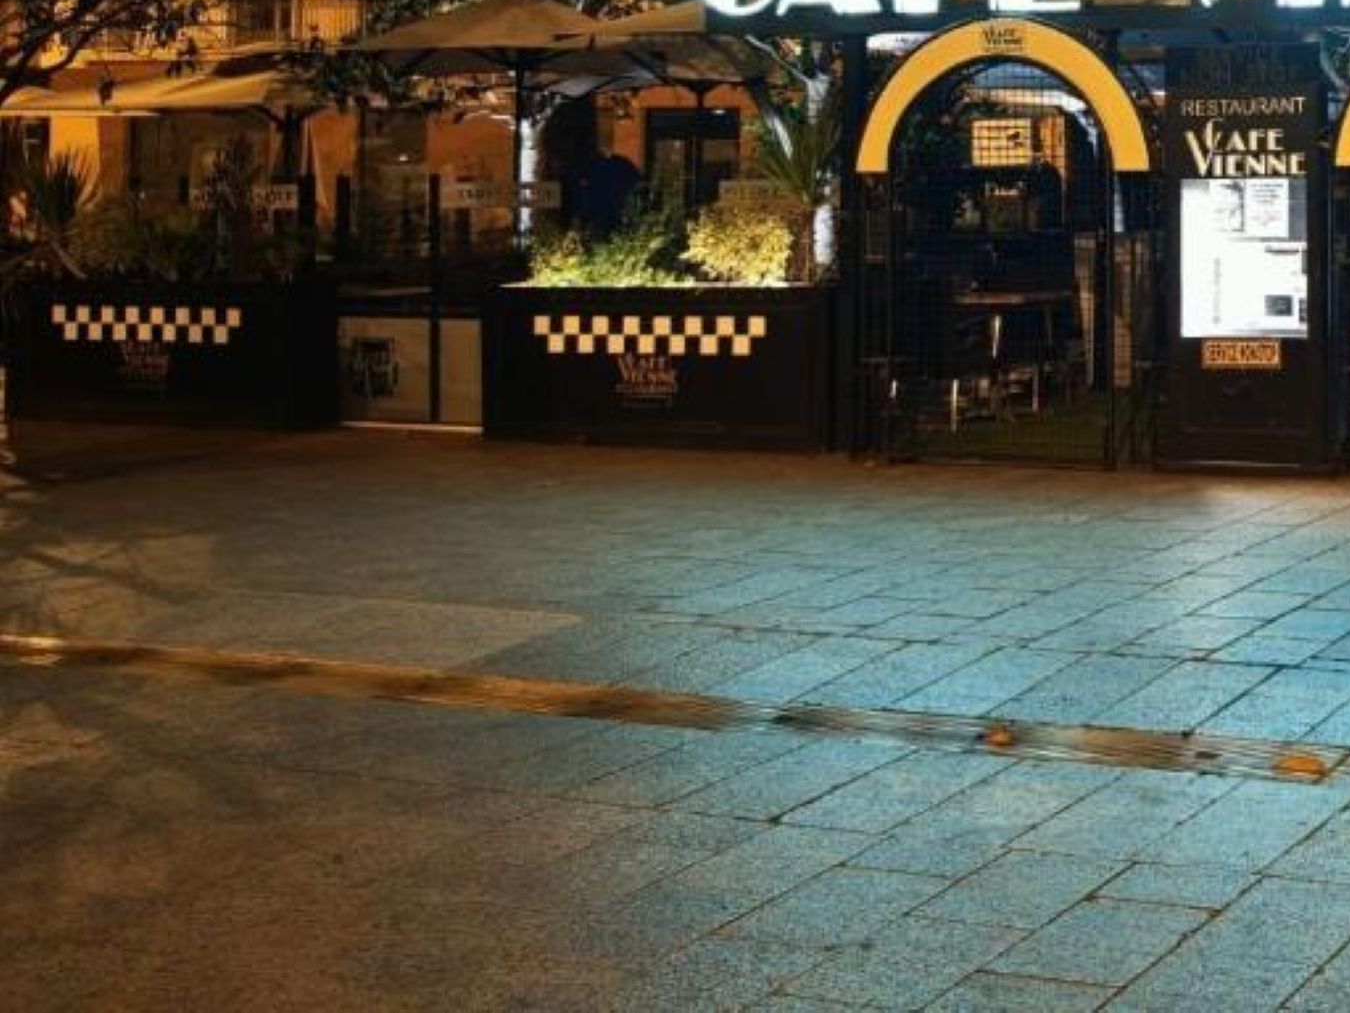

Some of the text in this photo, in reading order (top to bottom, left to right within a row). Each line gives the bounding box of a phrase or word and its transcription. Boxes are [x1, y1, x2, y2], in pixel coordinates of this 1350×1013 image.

[1181, 96, 1306, 116] RESTAURANT
[1204, 118, 1284, 153] CAFE
[1184, 130, 1307, 177] VIENNE
